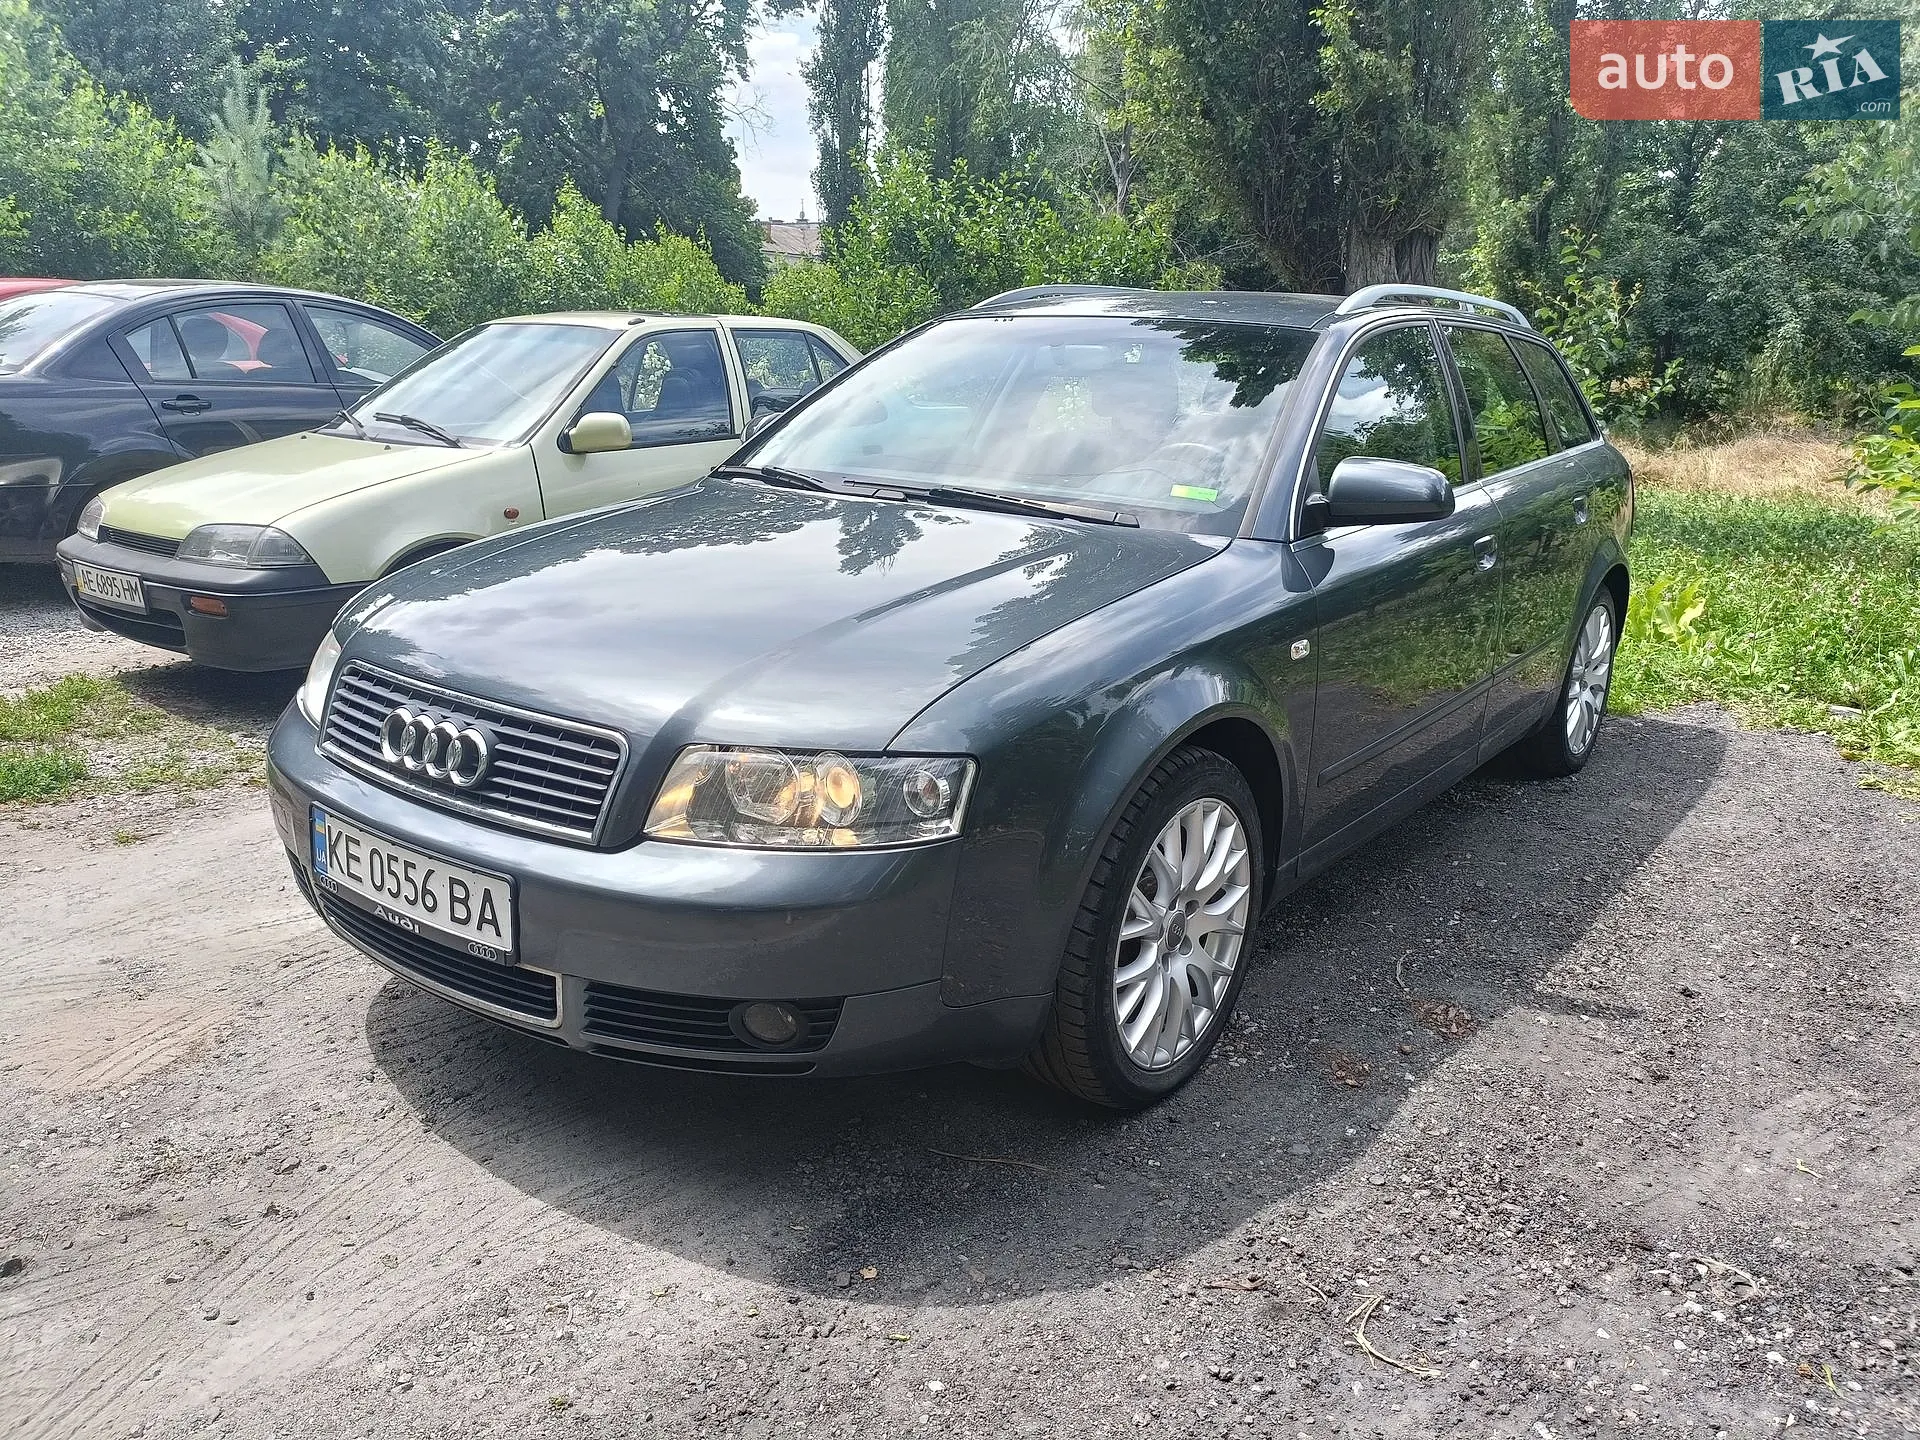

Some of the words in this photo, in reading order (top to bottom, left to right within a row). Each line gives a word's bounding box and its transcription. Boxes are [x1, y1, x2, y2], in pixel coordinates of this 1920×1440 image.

[81, 569, 96, 592] AE
[96, 573, 121, 599] 6895
[120, 578, 142, 603] HM
[316, 847, 327, 865] UA
[328, 824, 363, 883] KE
[369, 847, 438, 913] 0556
[448, 876, 502, 938] BA
